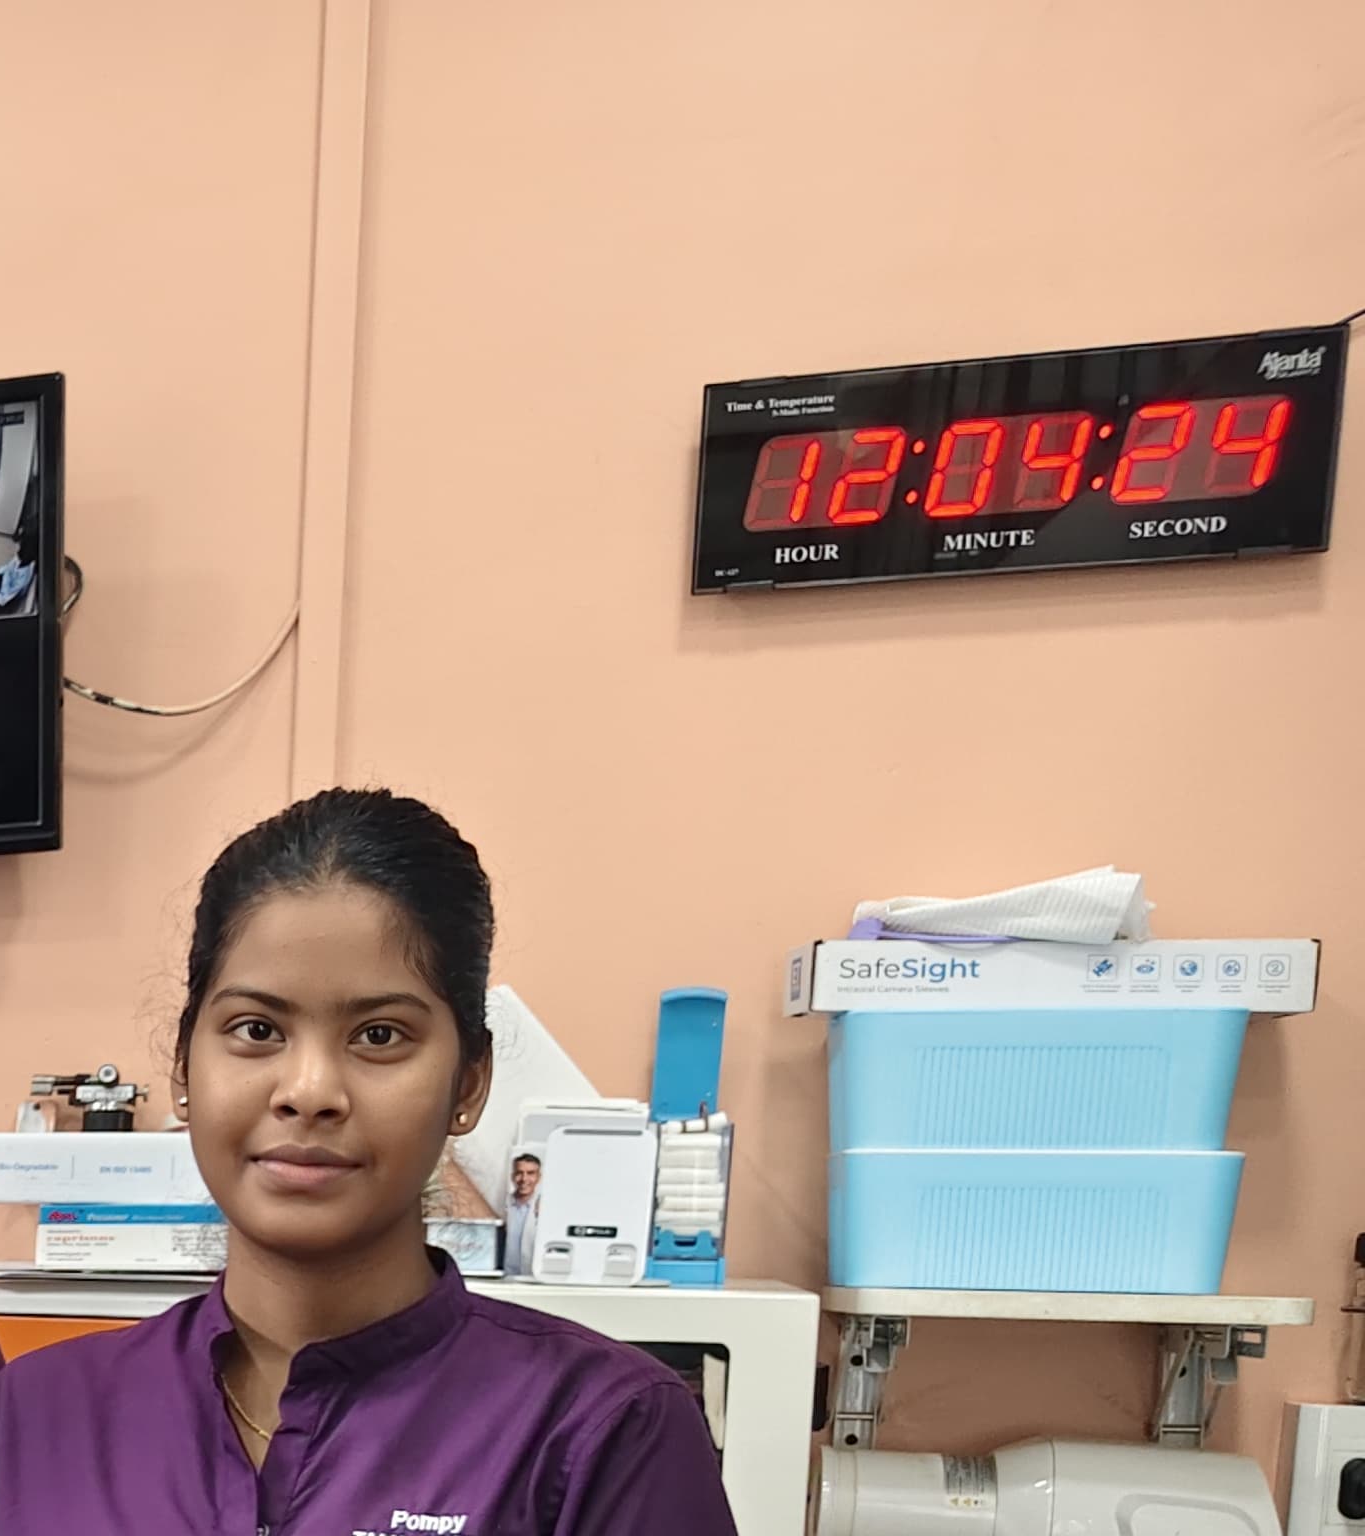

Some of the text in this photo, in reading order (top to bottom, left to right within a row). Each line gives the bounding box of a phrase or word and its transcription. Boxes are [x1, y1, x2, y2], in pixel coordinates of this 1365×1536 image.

[725, 395, 835, 412] Time & Temperature
[788, 399, 1291, 526] 12:04:24
[1129, 516, 1228, 540] SECOND
[943, 529, 1035, 553] MINUTE
[774, 543, 840, 564] HOUR
[839, 956, 981, 983] SafeSight
[877, 985, 913, 993] Camera
[390, 1510, 469, 1535] Pompy
